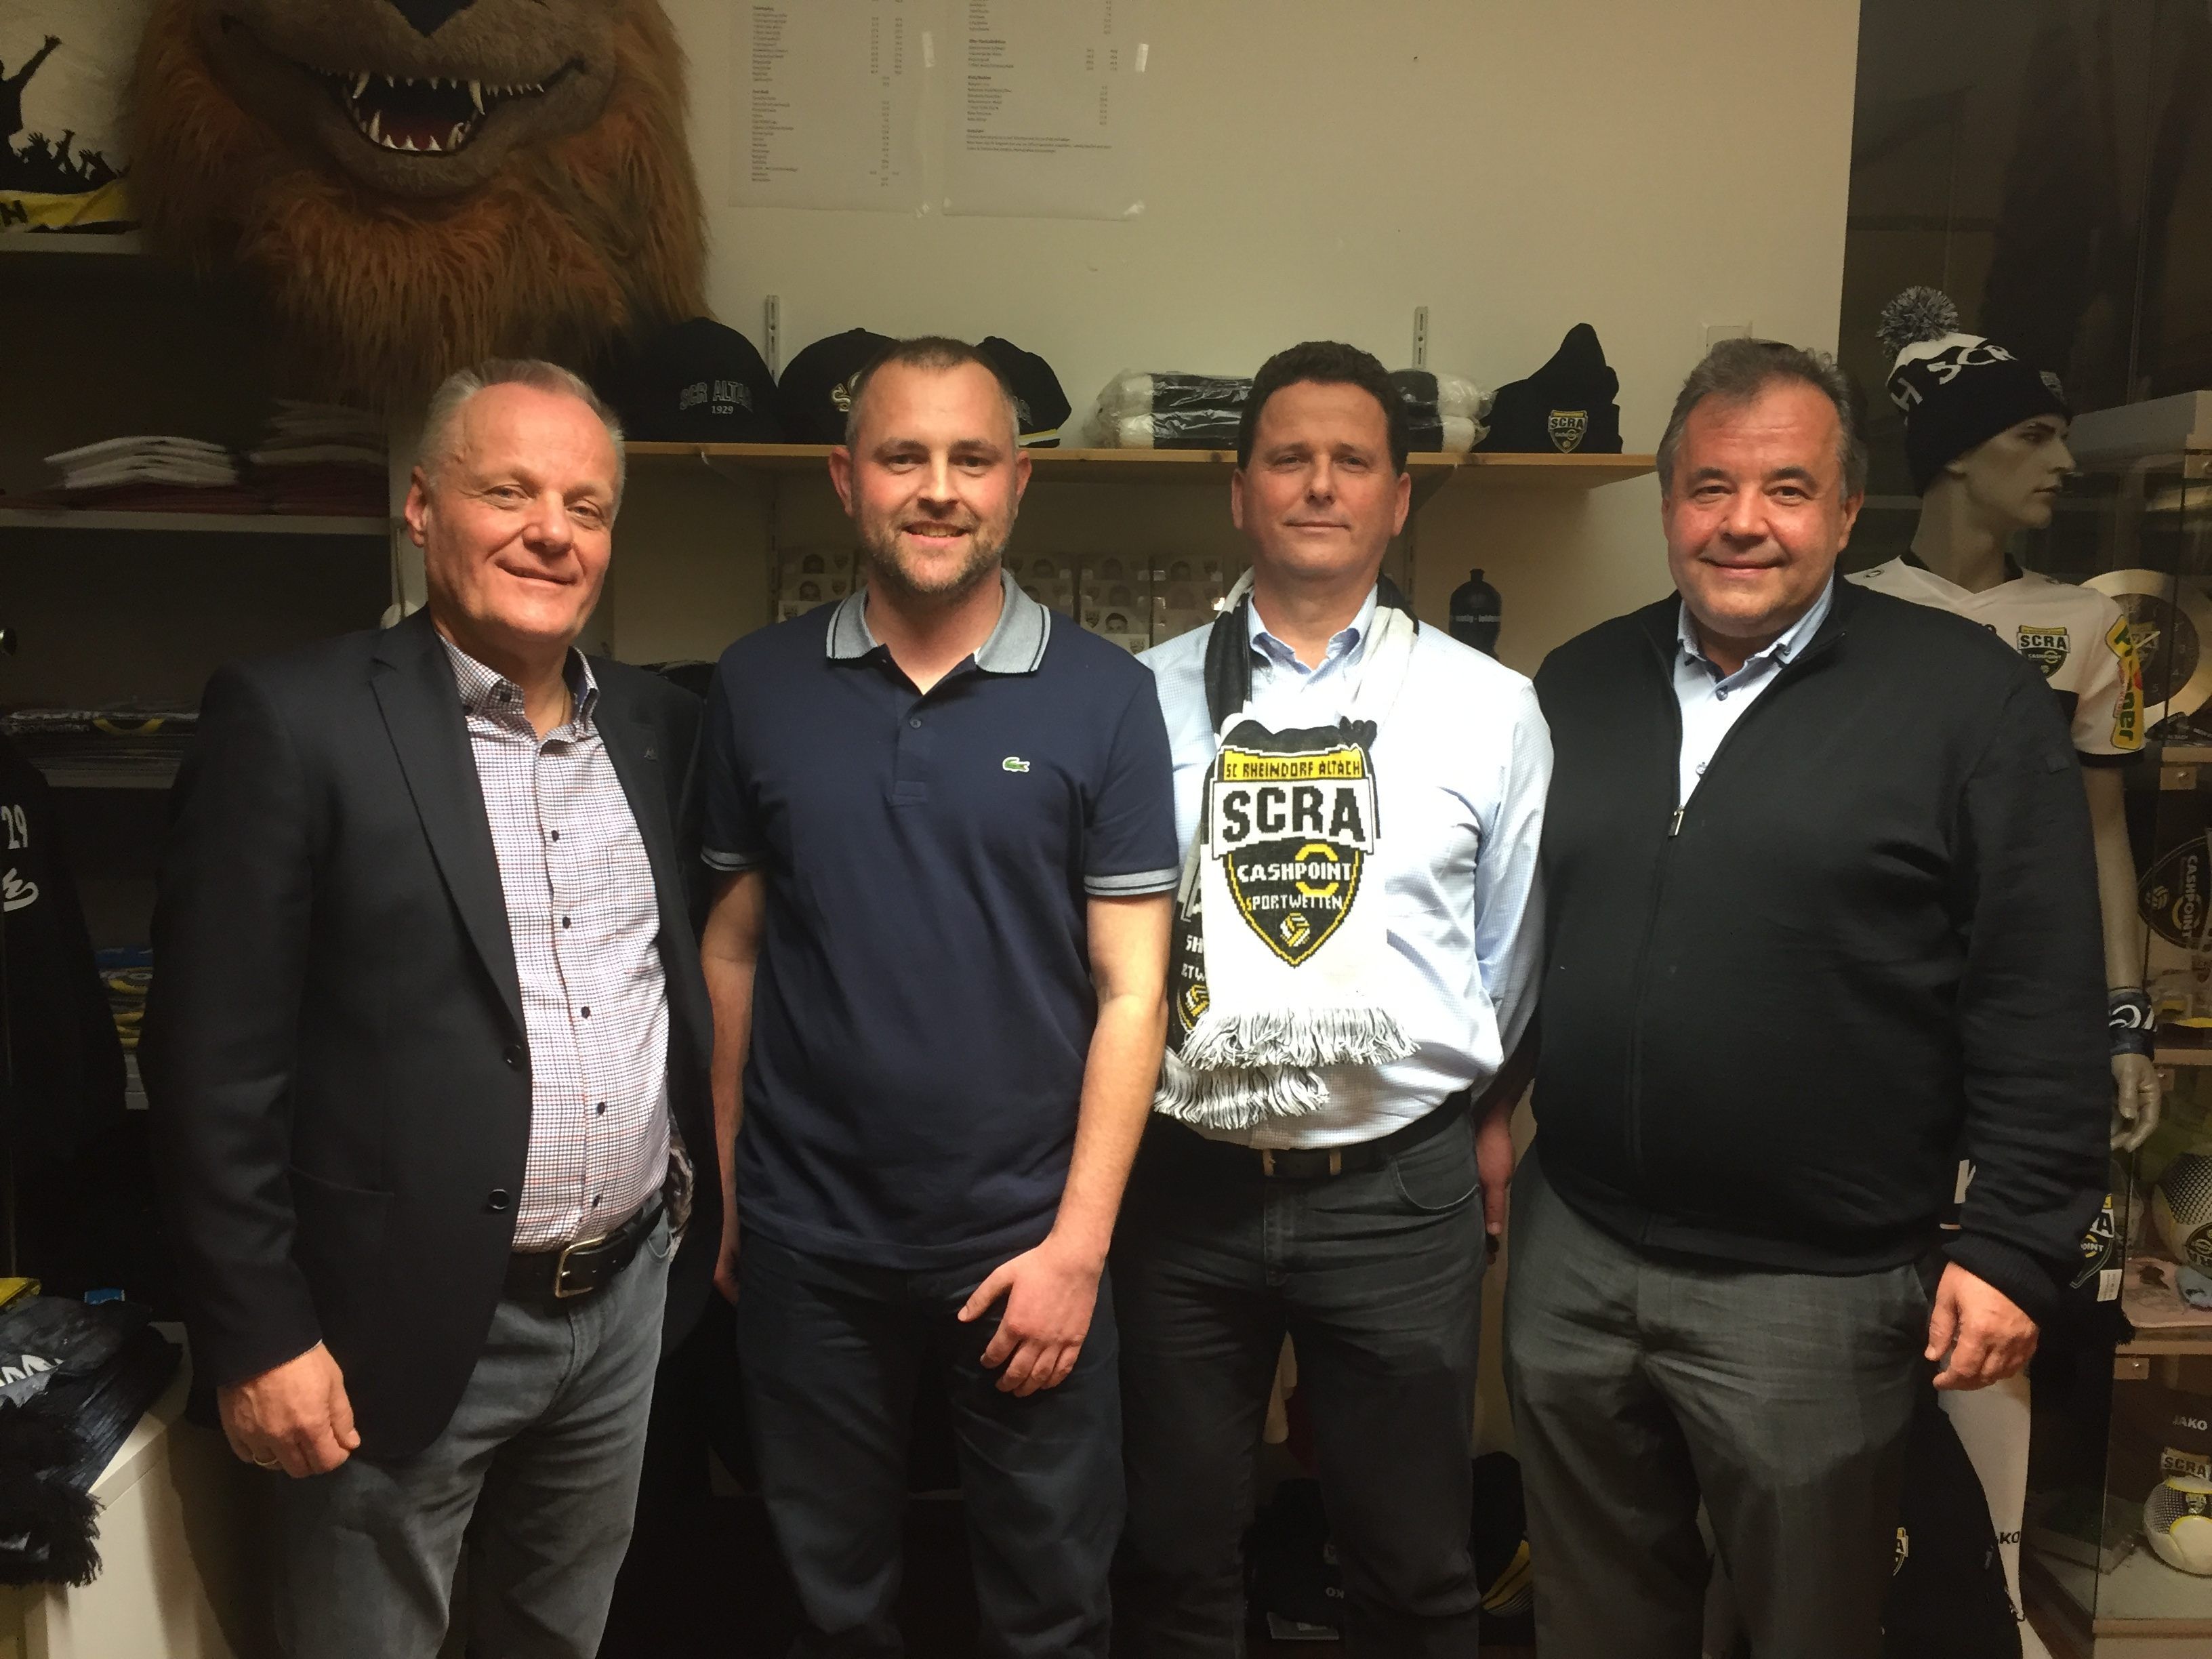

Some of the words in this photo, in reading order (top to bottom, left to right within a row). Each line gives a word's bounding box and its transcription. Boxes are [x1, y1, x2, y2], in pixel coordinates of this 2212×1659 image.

[712, 405, 734, 415] 1929
[1551, 417, 1584, 430] SCRA
[2020, 634, 2067, 650] SCRA
[1226, 763, 1237, 777] SC
[1242, 762, 1313, 777] RHEINDORF
[1319, 760, 1360, 776] ALTACH
[1223, 785, 1366, 842] SCRA
[1237, 862, 1351, 882] CASHPOINT
[1246, 893, 1343, 911] SPORTWETTEN
[2182, 855, 2198, 939] CASHPOINT
[2173, 1414, 2209, 1431] JAKO
[2164, 1456, 2207, 1477] SCRA
